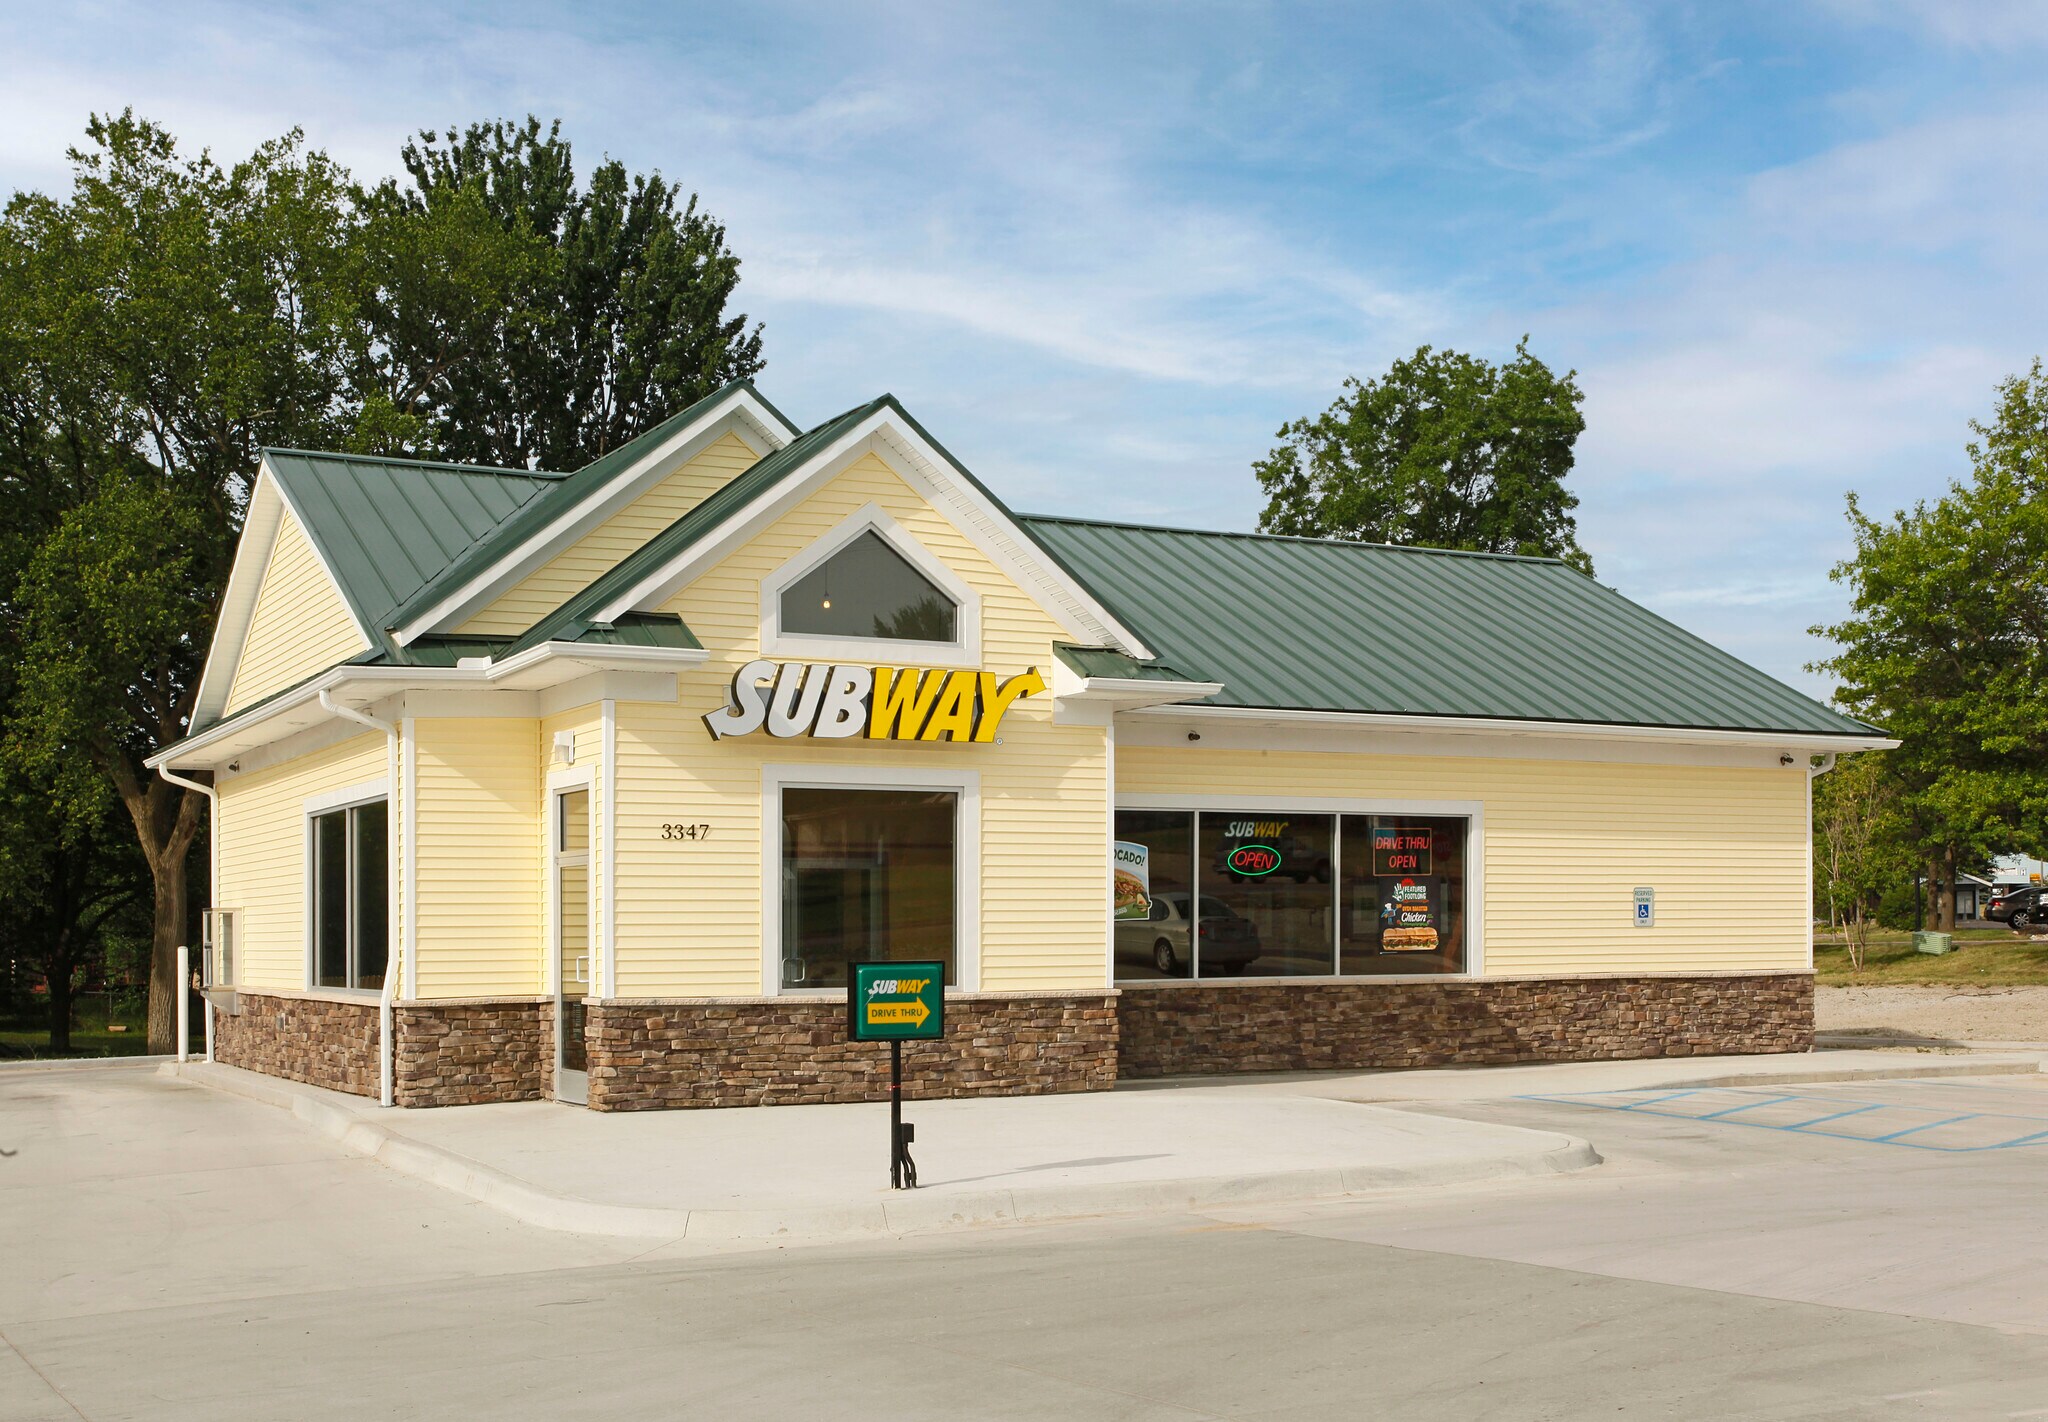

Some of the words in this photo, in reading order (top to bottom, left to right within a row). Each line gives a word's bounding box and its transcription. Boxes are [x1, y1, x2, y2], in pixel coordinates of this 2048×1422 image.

[701, 659, 1047, 743] SUBWAY
[661, 823, 710, 841] 3347
[1224, 821, 1289, 838] SUBWAY
[1375, 836, 1403, 849] DRIVE
[1405, 836, 1430, 850] THRU
[1234, 850, 1275, 869] OPEN
[1389, 855, 1417, 868] OPEN
[1401, 912, 1426, 922] Chicken
[868, 978, 930, 994] SUBWAY
[871, 1008, 897, 1017] DRIVE
[900, 1008, 922, 1016] THRU
